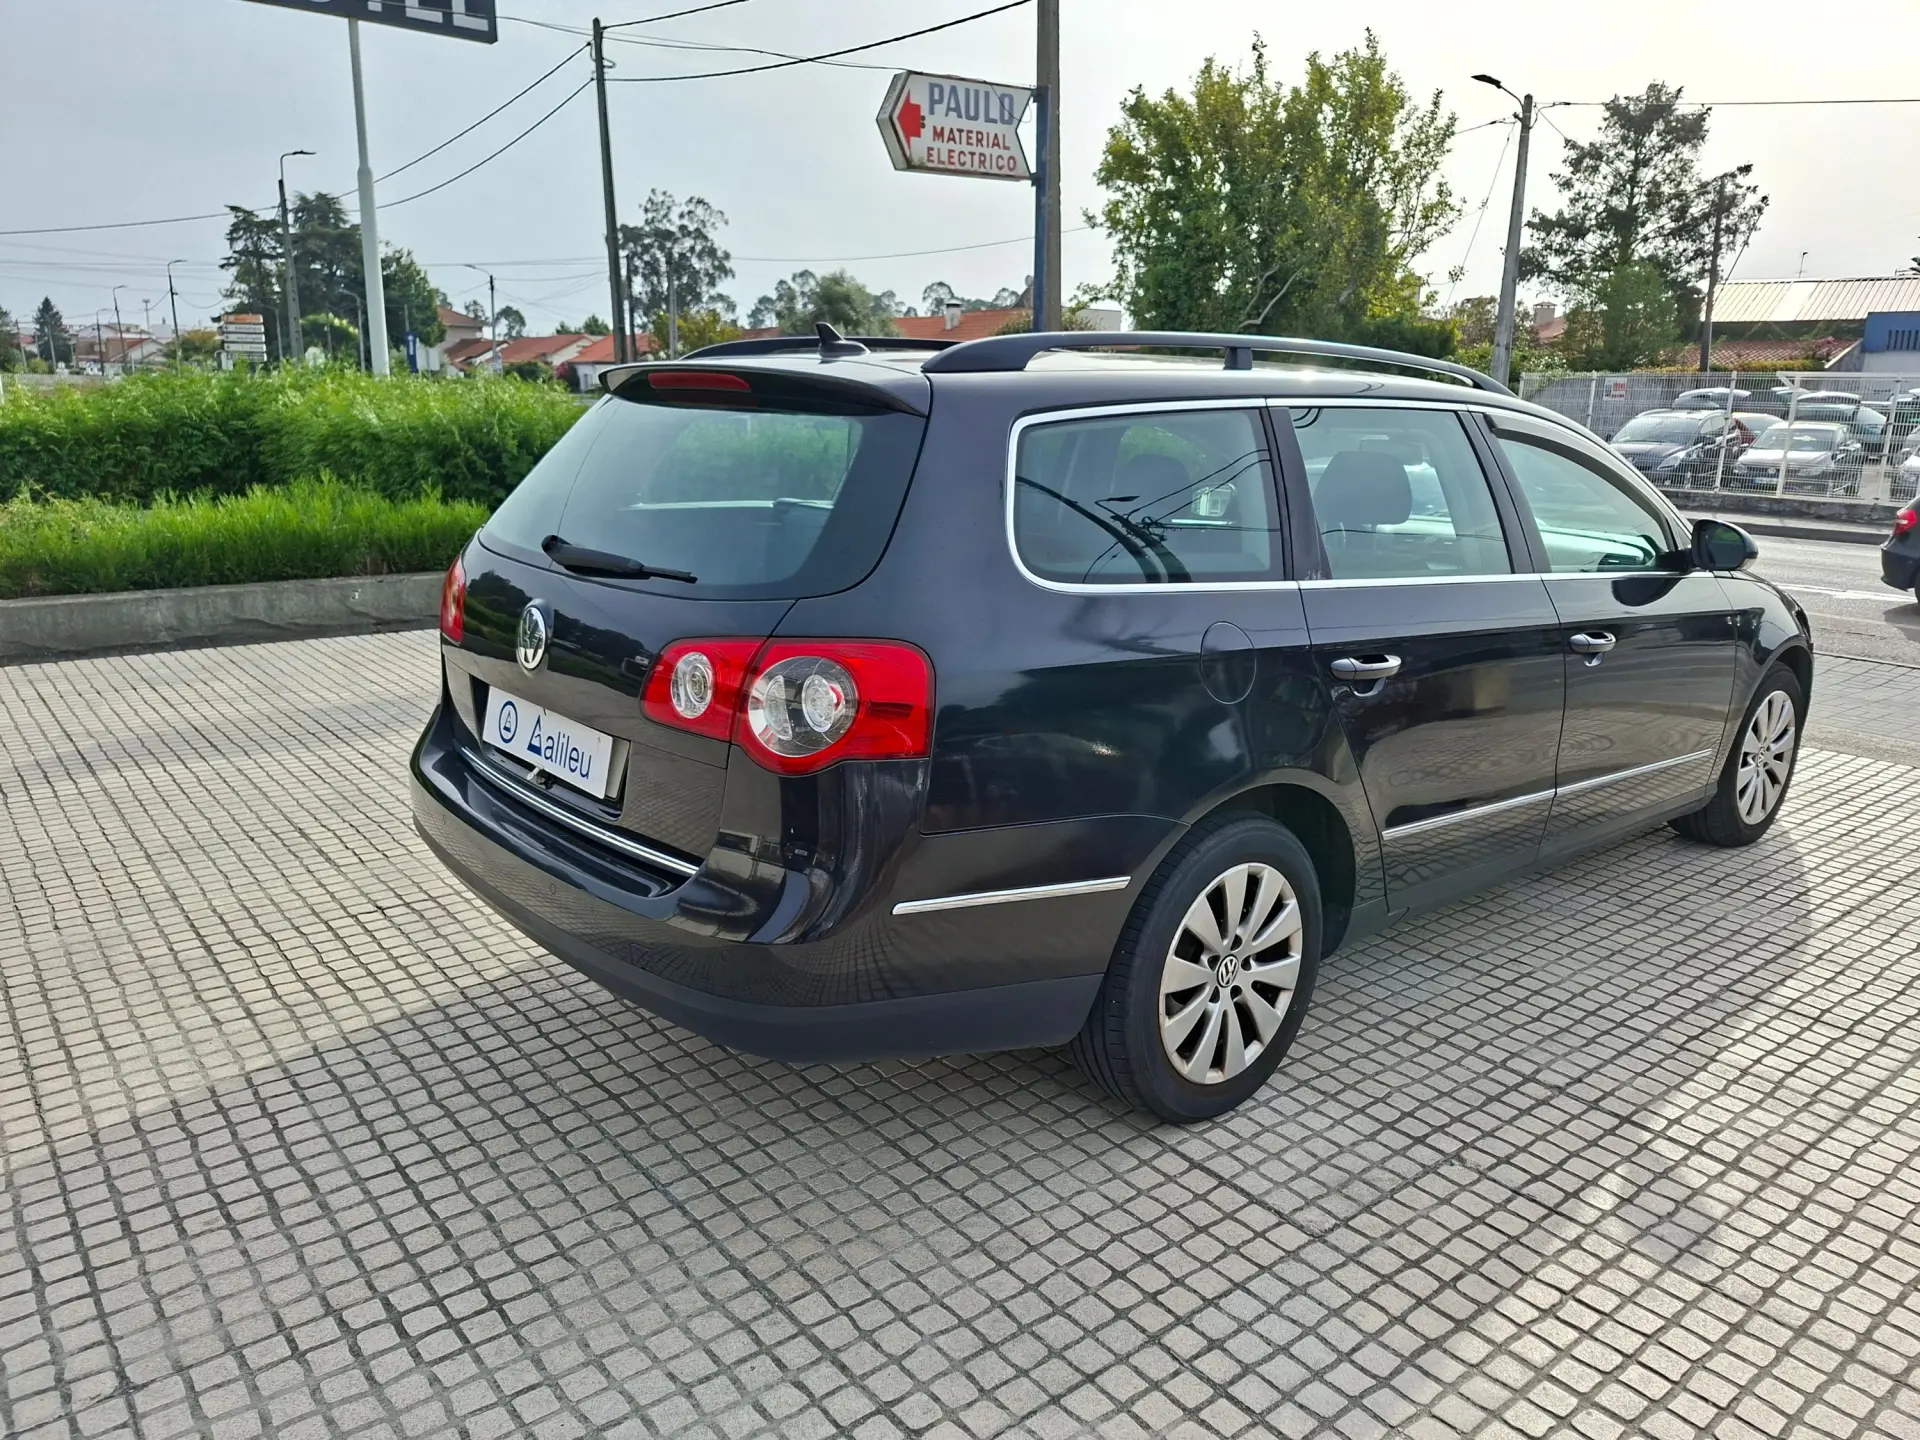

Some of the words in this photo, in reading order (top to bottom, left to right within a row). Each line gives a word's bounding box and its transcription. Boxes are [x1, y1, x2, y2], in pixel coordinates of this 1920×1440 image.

[928, 82, 1014, 126] PAULO
[932, 125, 1011, 151] MATERIAL
[926, 146, 1017, 172] ELECTRICO
